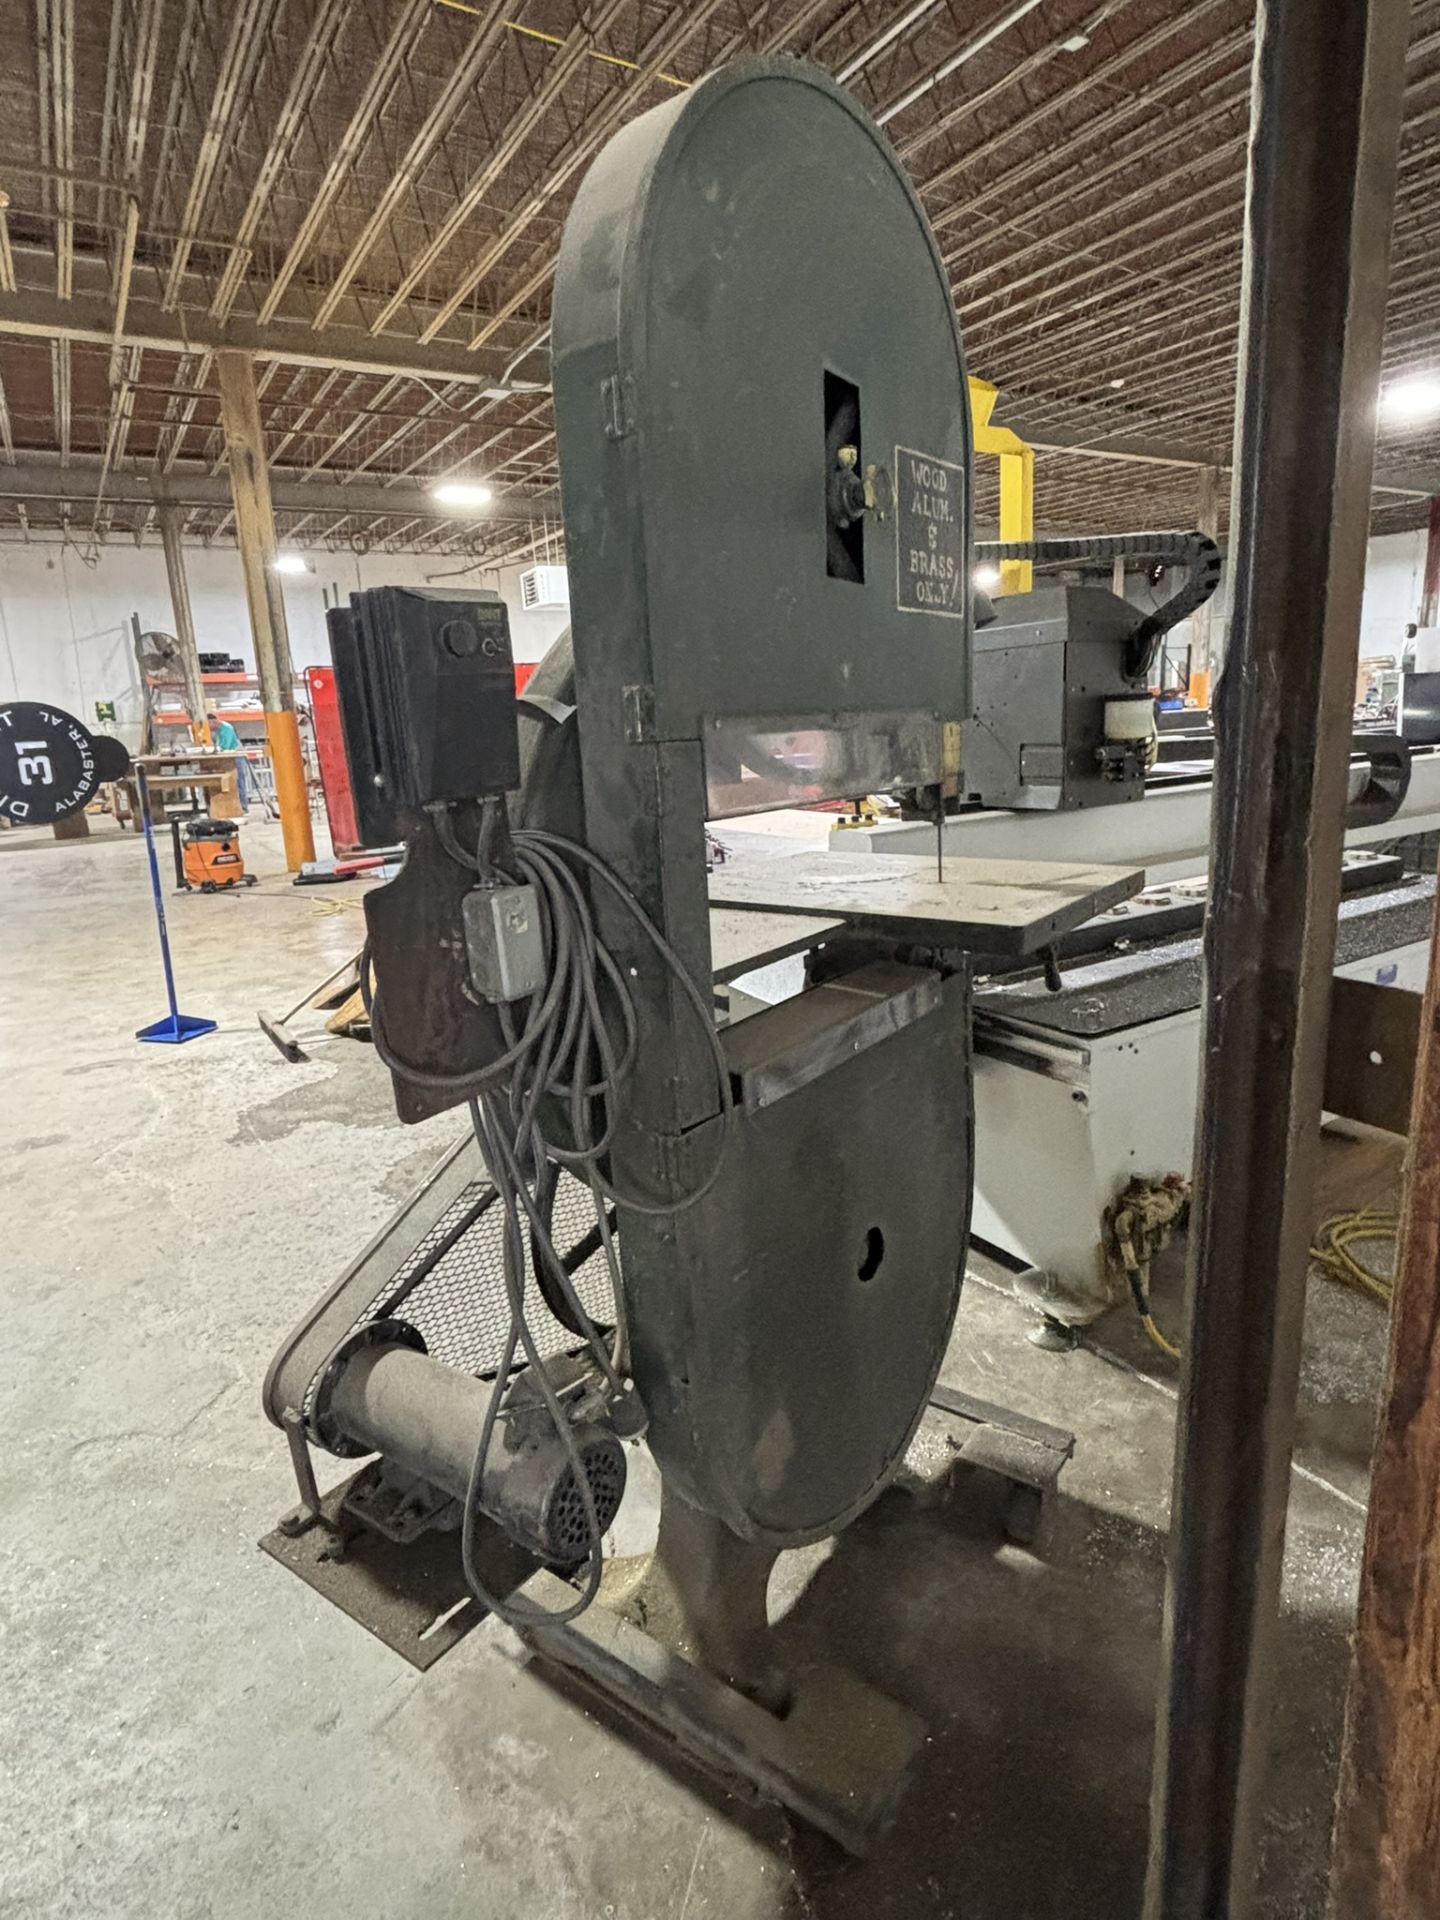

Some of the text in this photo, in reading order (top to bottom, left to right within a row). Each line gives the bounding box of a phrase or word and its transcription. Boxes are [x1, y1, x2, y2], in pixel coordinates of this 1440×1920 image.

[911, 492, 953, 522] ALUM.
[910, 550, 953, 578] BRASS
[39, 711, 63, 726] AL
[14, 740, 53, 785] 31
